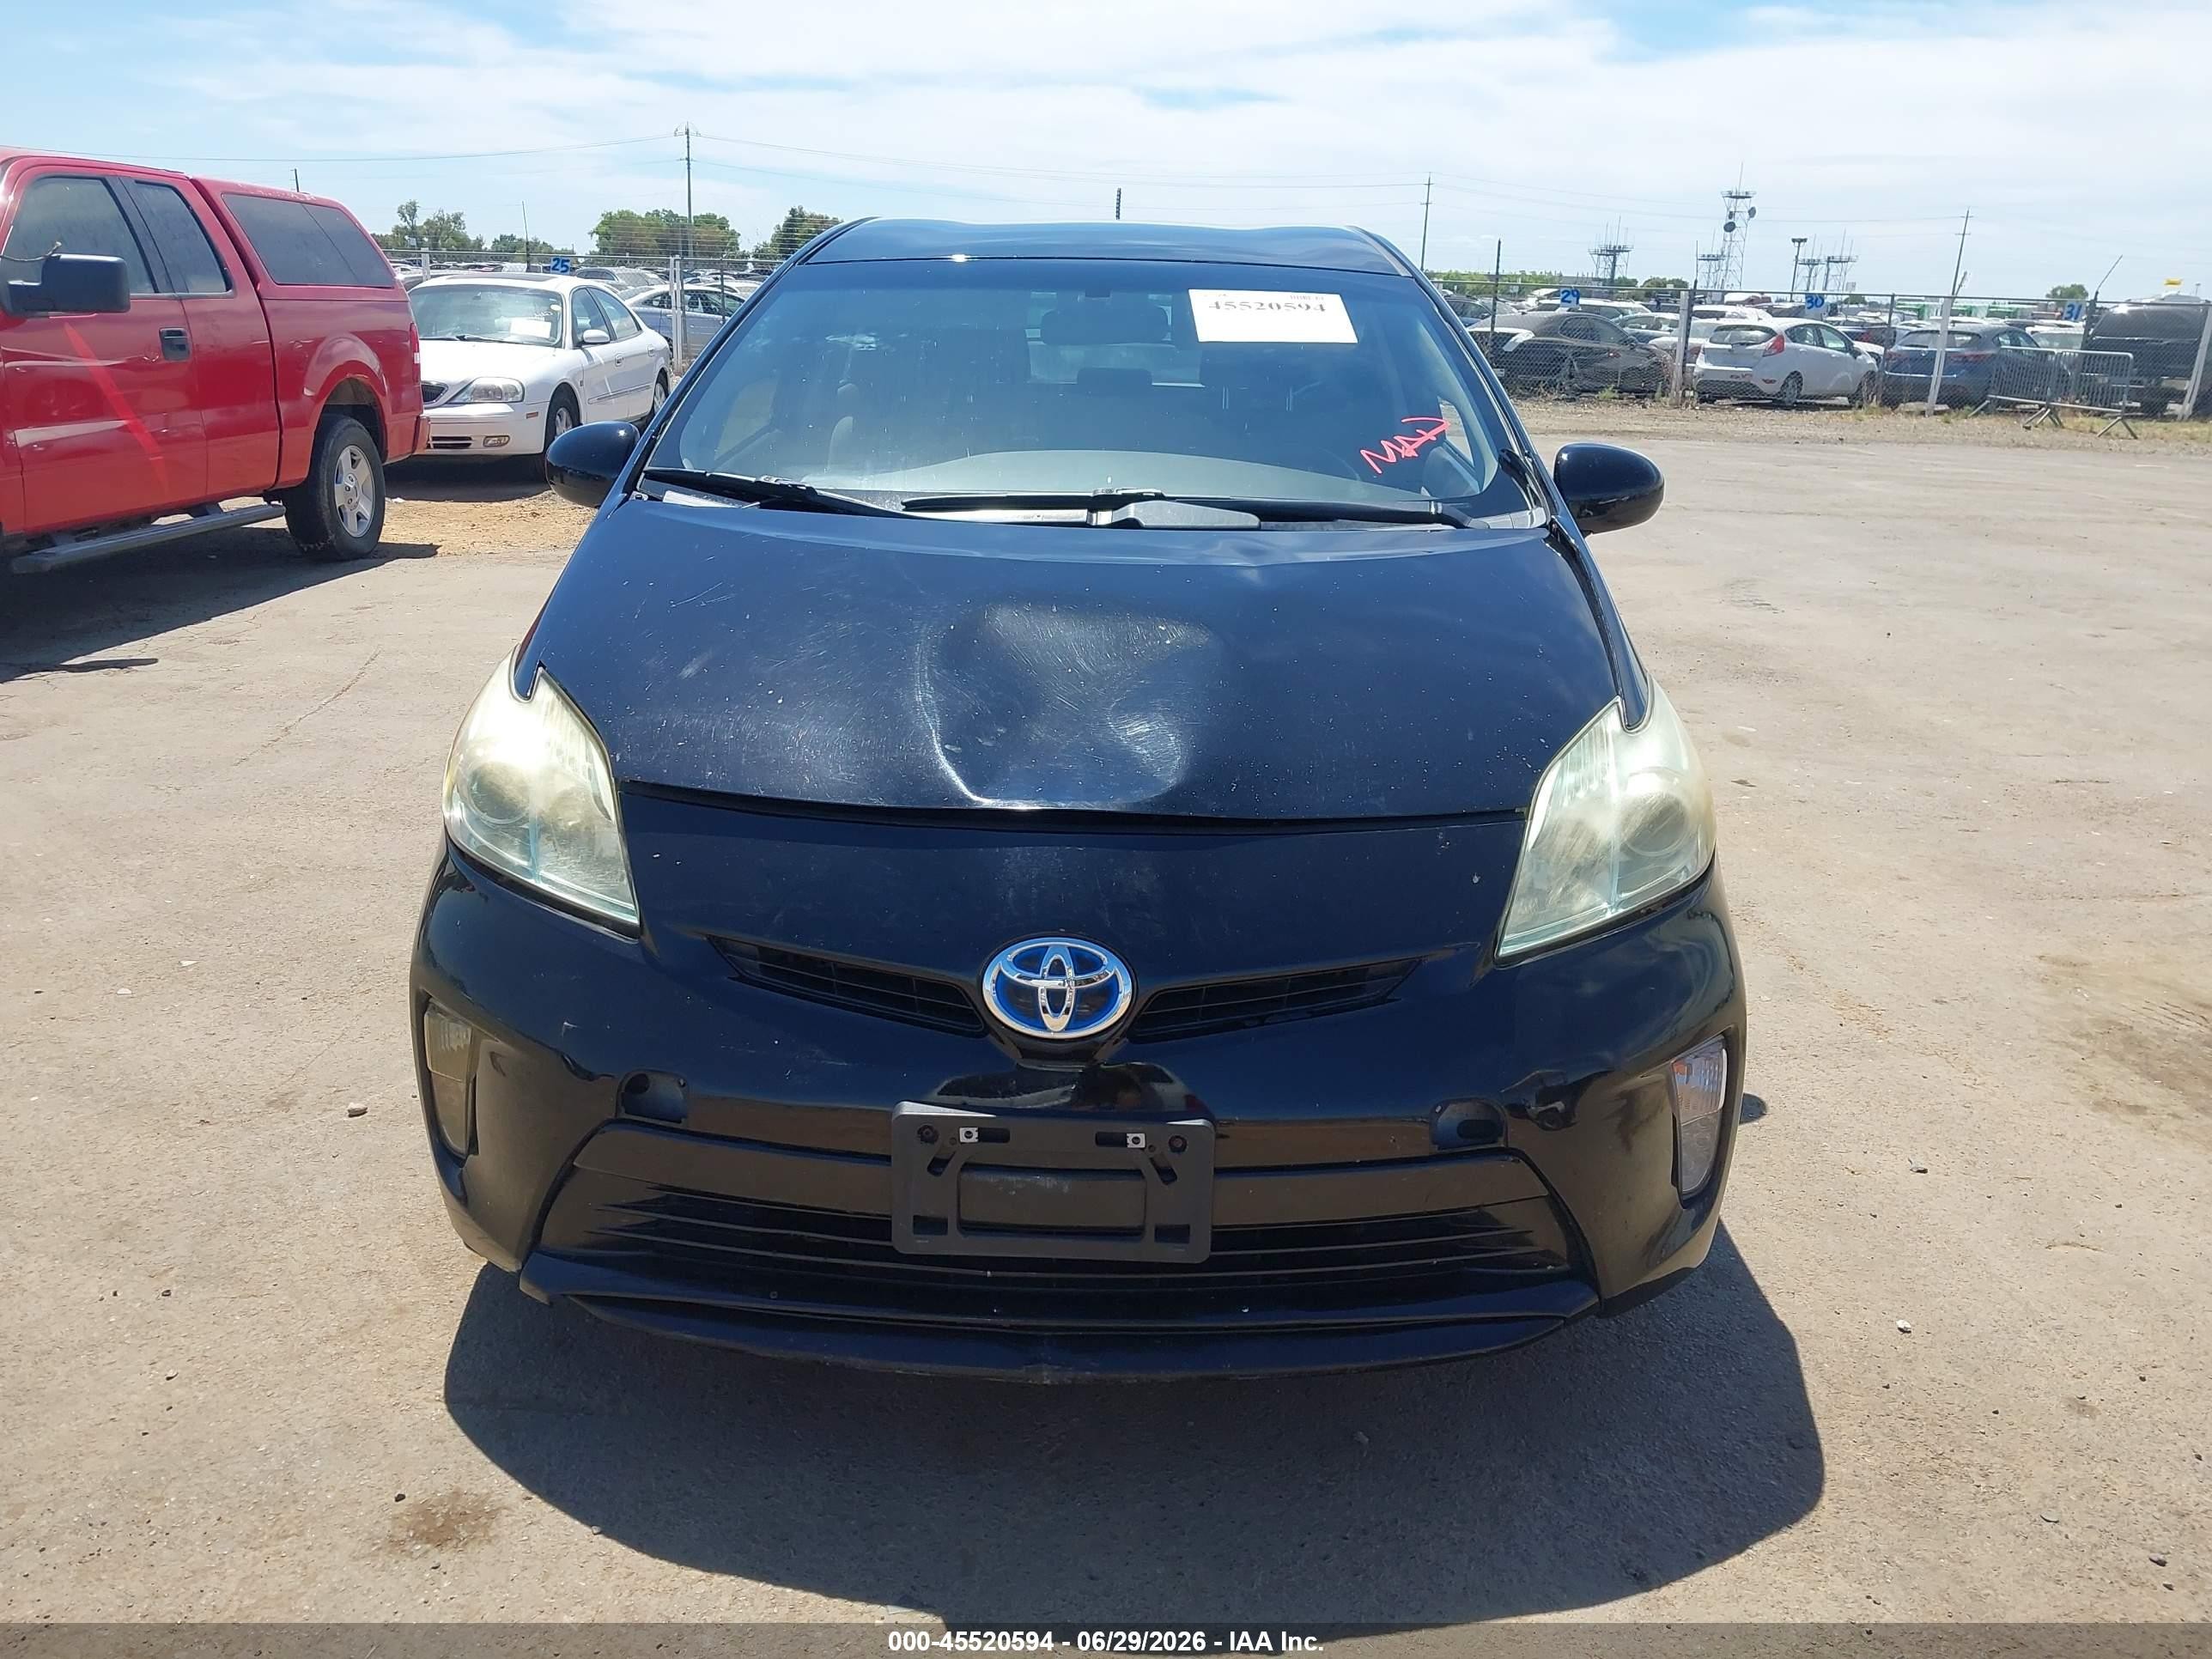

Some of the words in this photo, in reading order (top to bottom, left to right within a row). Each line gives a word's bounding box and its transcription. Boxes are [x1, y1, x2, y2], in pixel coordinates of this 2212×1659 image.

[551, 257, 570, 273] 25
[1561, 289, 1581, 305] 29
[1806, 295, 1825, 310] 30
[2063, 303, 2083, 319] 31
